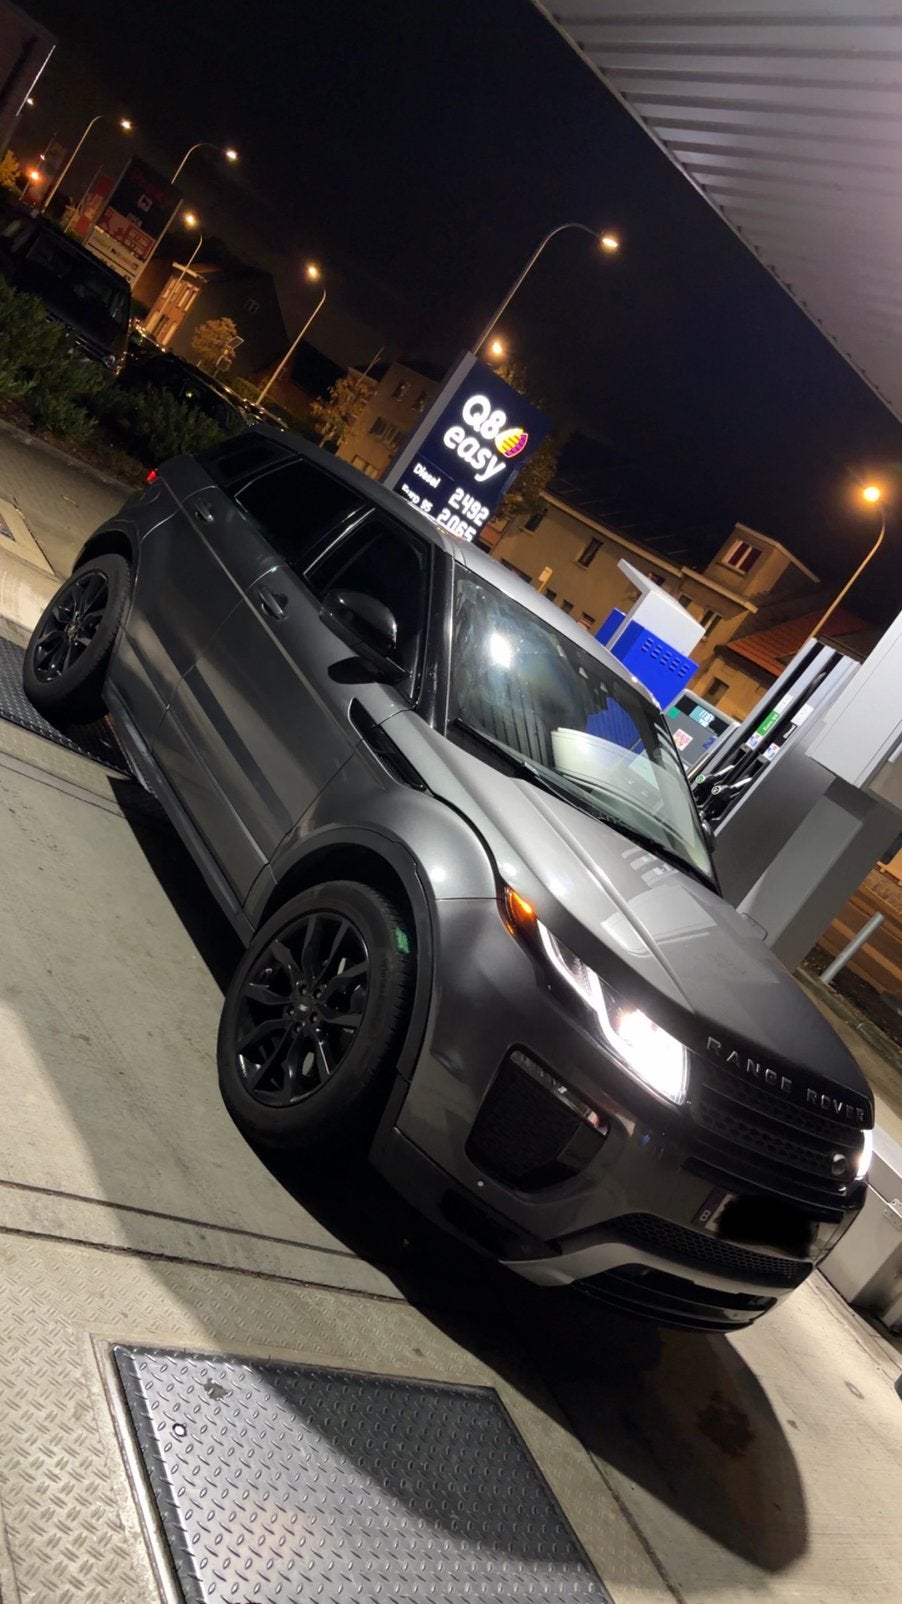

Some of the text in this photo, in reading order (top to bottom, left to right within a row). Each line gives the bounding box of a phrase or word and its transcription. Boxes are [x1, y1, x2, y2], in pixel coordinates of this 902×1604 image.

[462, 394, 507, 440] Q8
[443, 426, 507, 482] easy
[413, 462, 441, 489] Diesel
[420, 498, 434, 513] 95
[707, 1036, 865, 1122] RANGE ROVER
[700, 1209, 711, 1222] B
